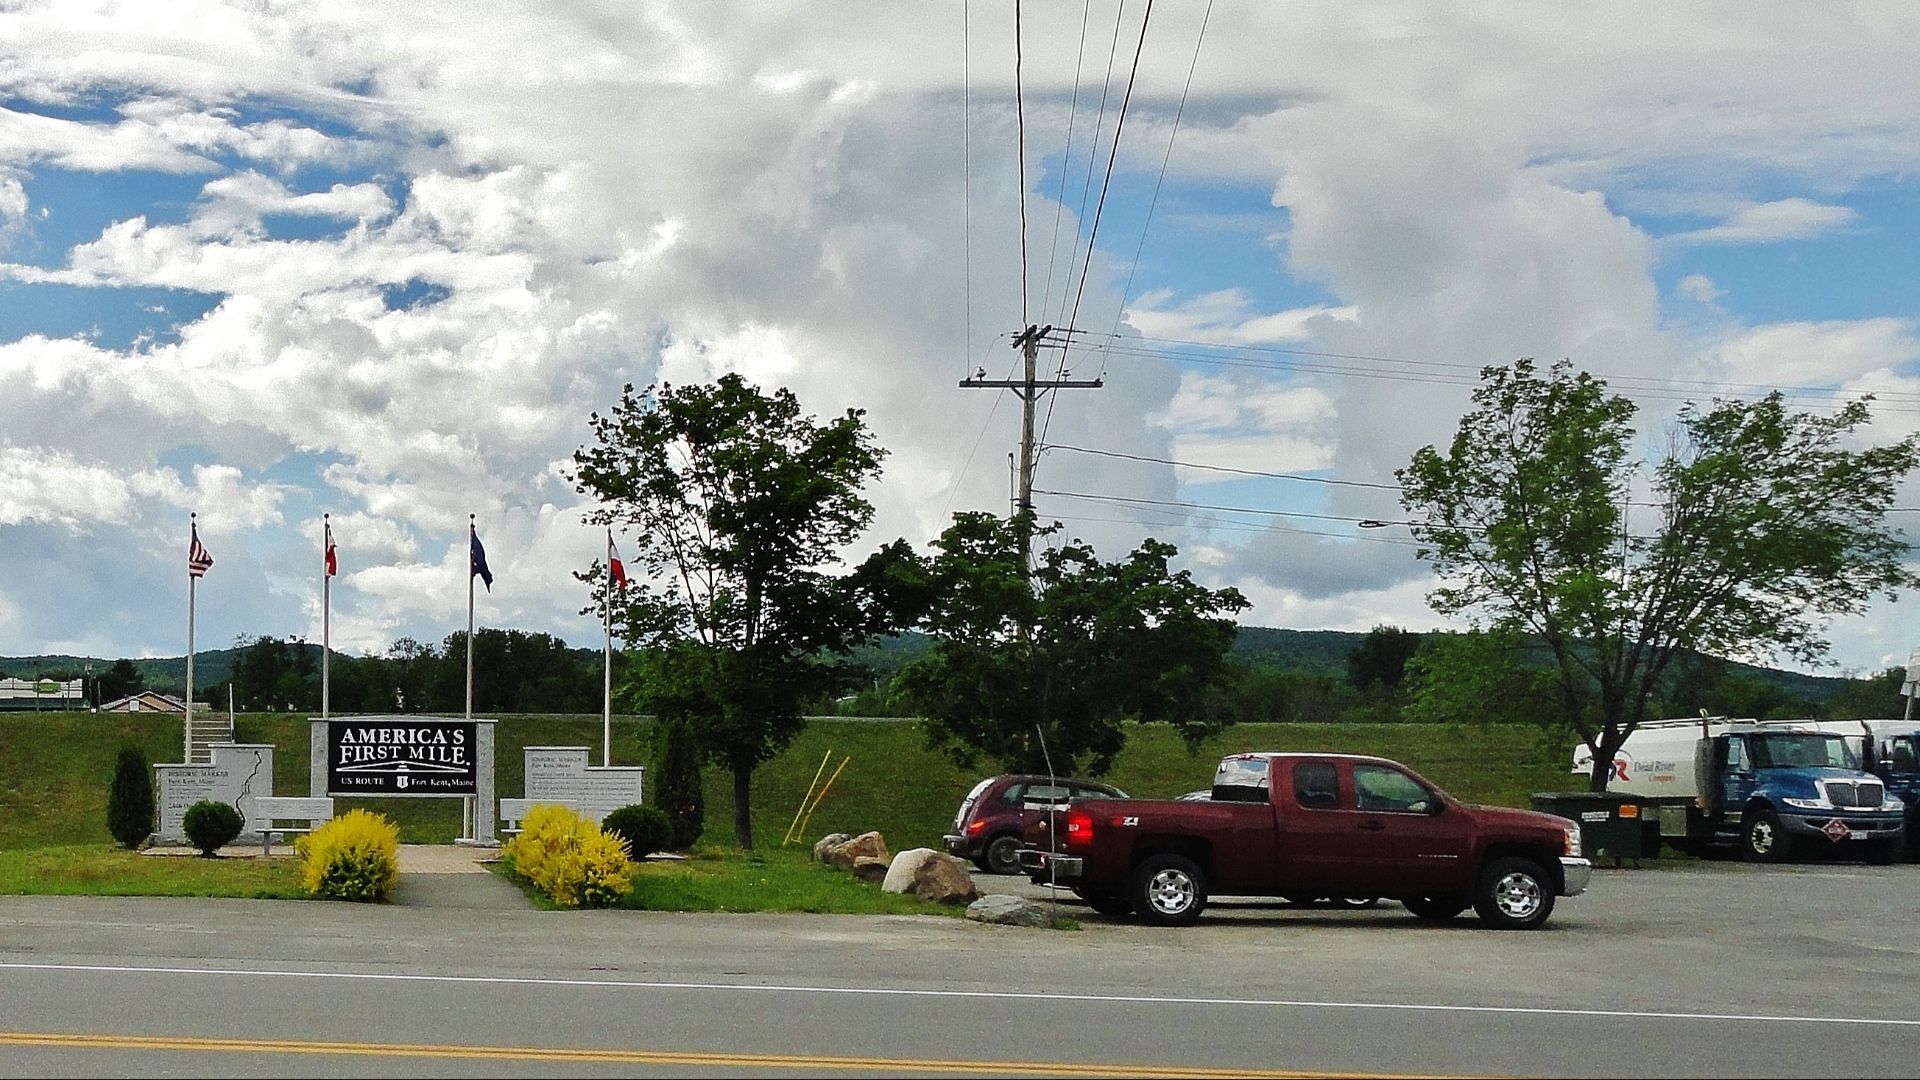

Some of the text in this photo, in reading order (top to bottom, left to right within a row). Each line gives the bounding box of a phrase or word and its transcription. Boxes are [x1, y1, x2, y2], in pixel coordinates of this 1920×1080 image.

[341, 728, 465, 745] AMERICA'S
[338, 745, 402, 764] FIRST
[341, 777, 353, 785] US
[355, 777, 385, 785] ROUTE
[411, 778, 427, 786] Fort
